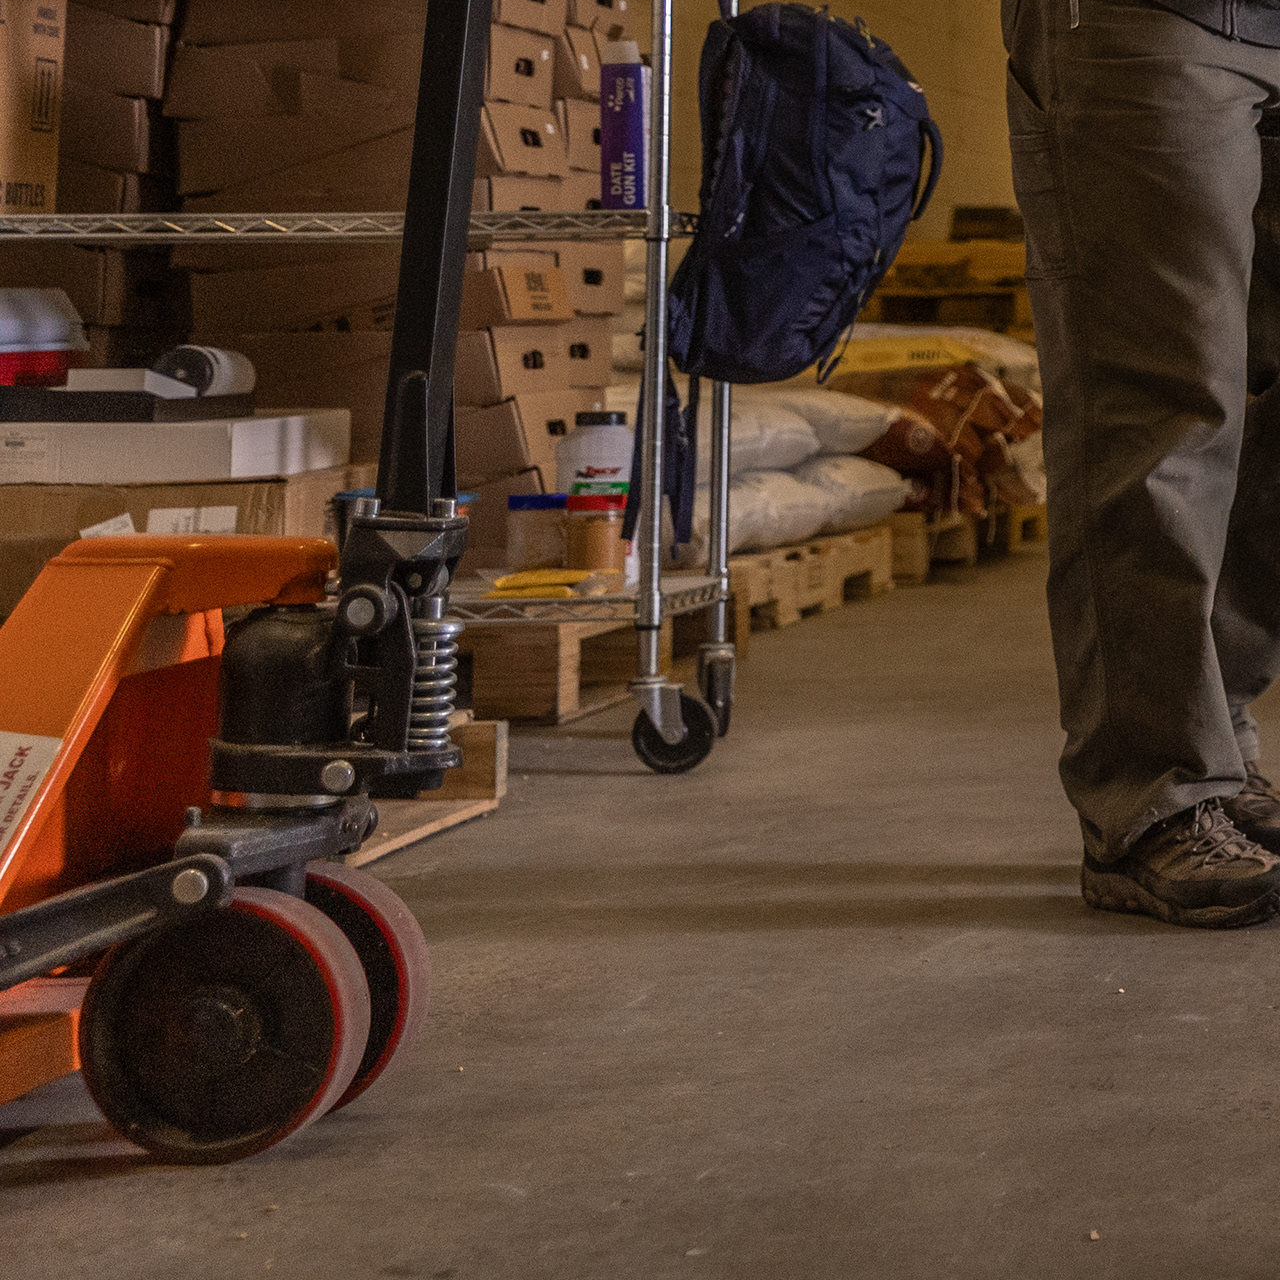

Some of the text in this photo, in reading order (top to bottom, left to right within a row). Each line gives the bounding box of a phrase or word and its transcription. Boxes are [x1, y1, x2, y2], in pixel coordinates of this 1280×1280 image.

[5, 181, 46, 208] BOTTLES
[610, 161, 622, 196] DATE
[623, 151, 636, 205] GUN KIT
[0, 745, 33, 791] JACK
